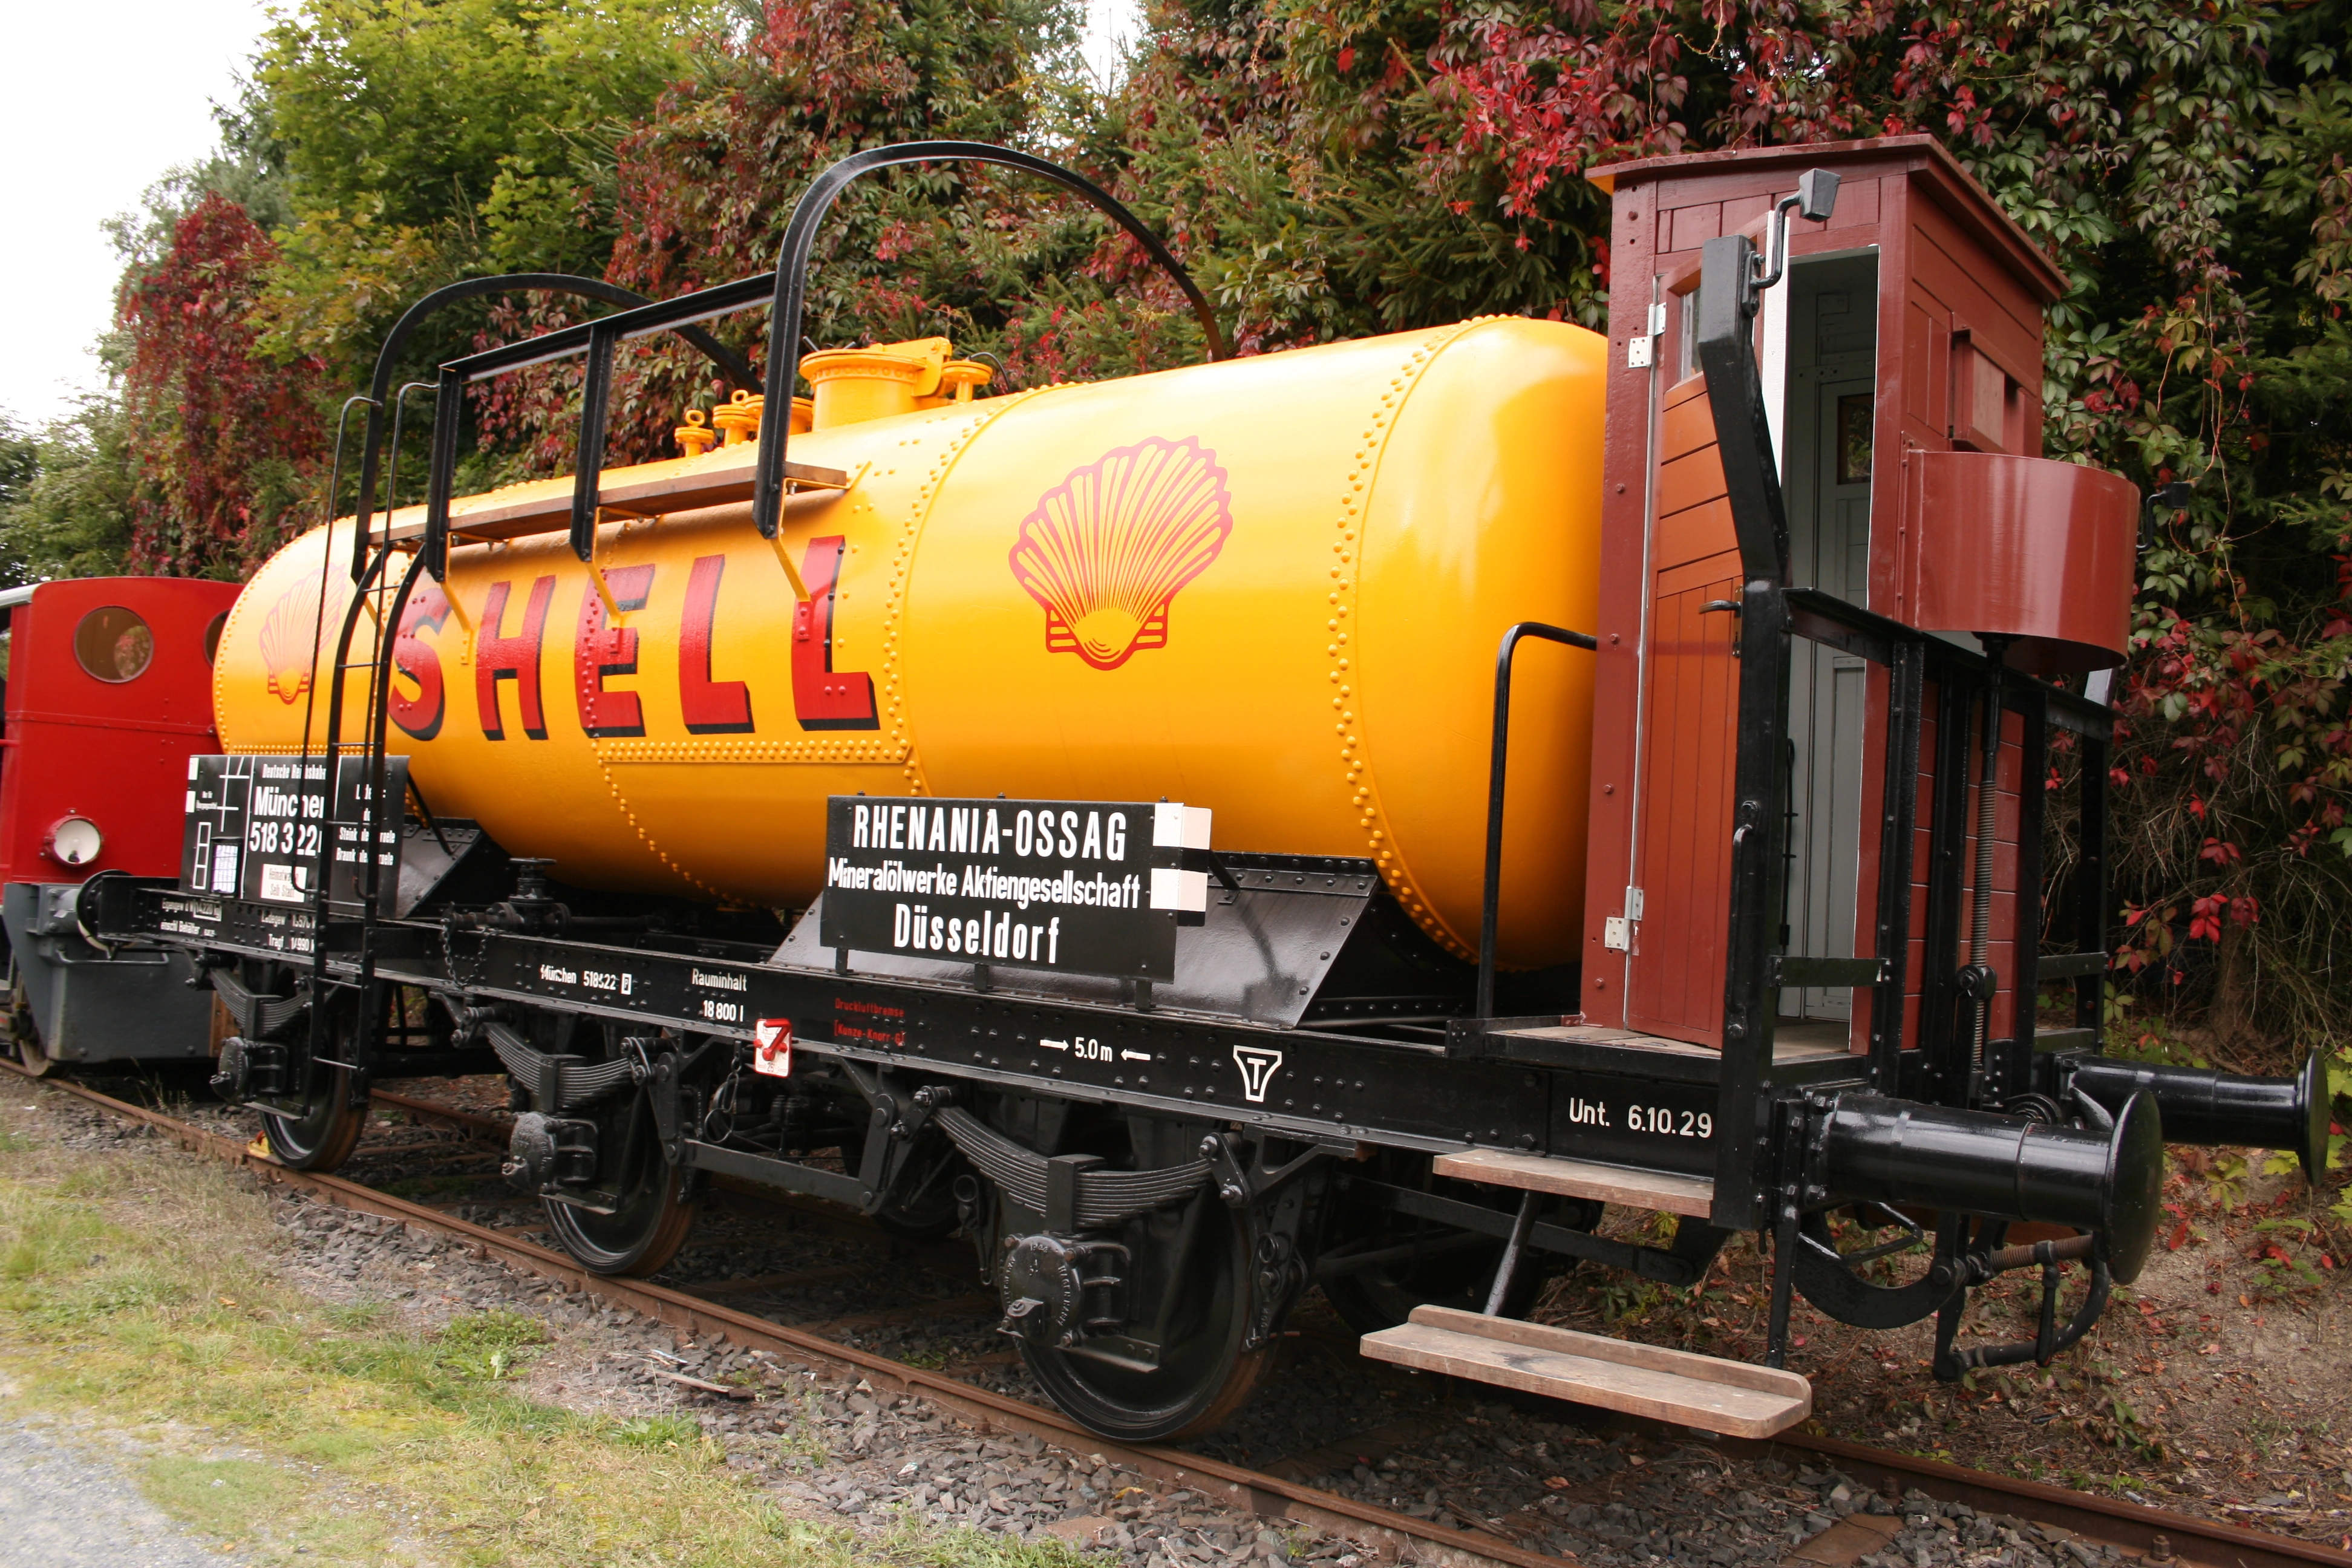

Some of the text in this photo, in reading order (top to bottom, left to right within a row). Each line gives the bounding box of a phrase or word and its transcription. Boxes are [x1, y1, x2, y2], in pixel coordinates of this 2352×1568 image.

[387, 535, 881, 741] SHELL
[291, 763, 327, 780] Reihsbahn
[852, 804, 1127, 861] RHENANIA-OSSAG
[827, 857, 1141, 909] Mineralölwerke Aktiengesellschaft
[893, 903, 1060, 964] Düsseldorf
[540, 964, 577, 984] München
[691, 968, 747, 991] Rauminhalt
[834, 998, 905, 1018] Druckluftbremse
[1074, 1036, 1113, 1062] 5.0 m
[1247, 1057, 1267, 1089] T
[1569, 1097, 1713, 1138] Unt. 6.10.29
